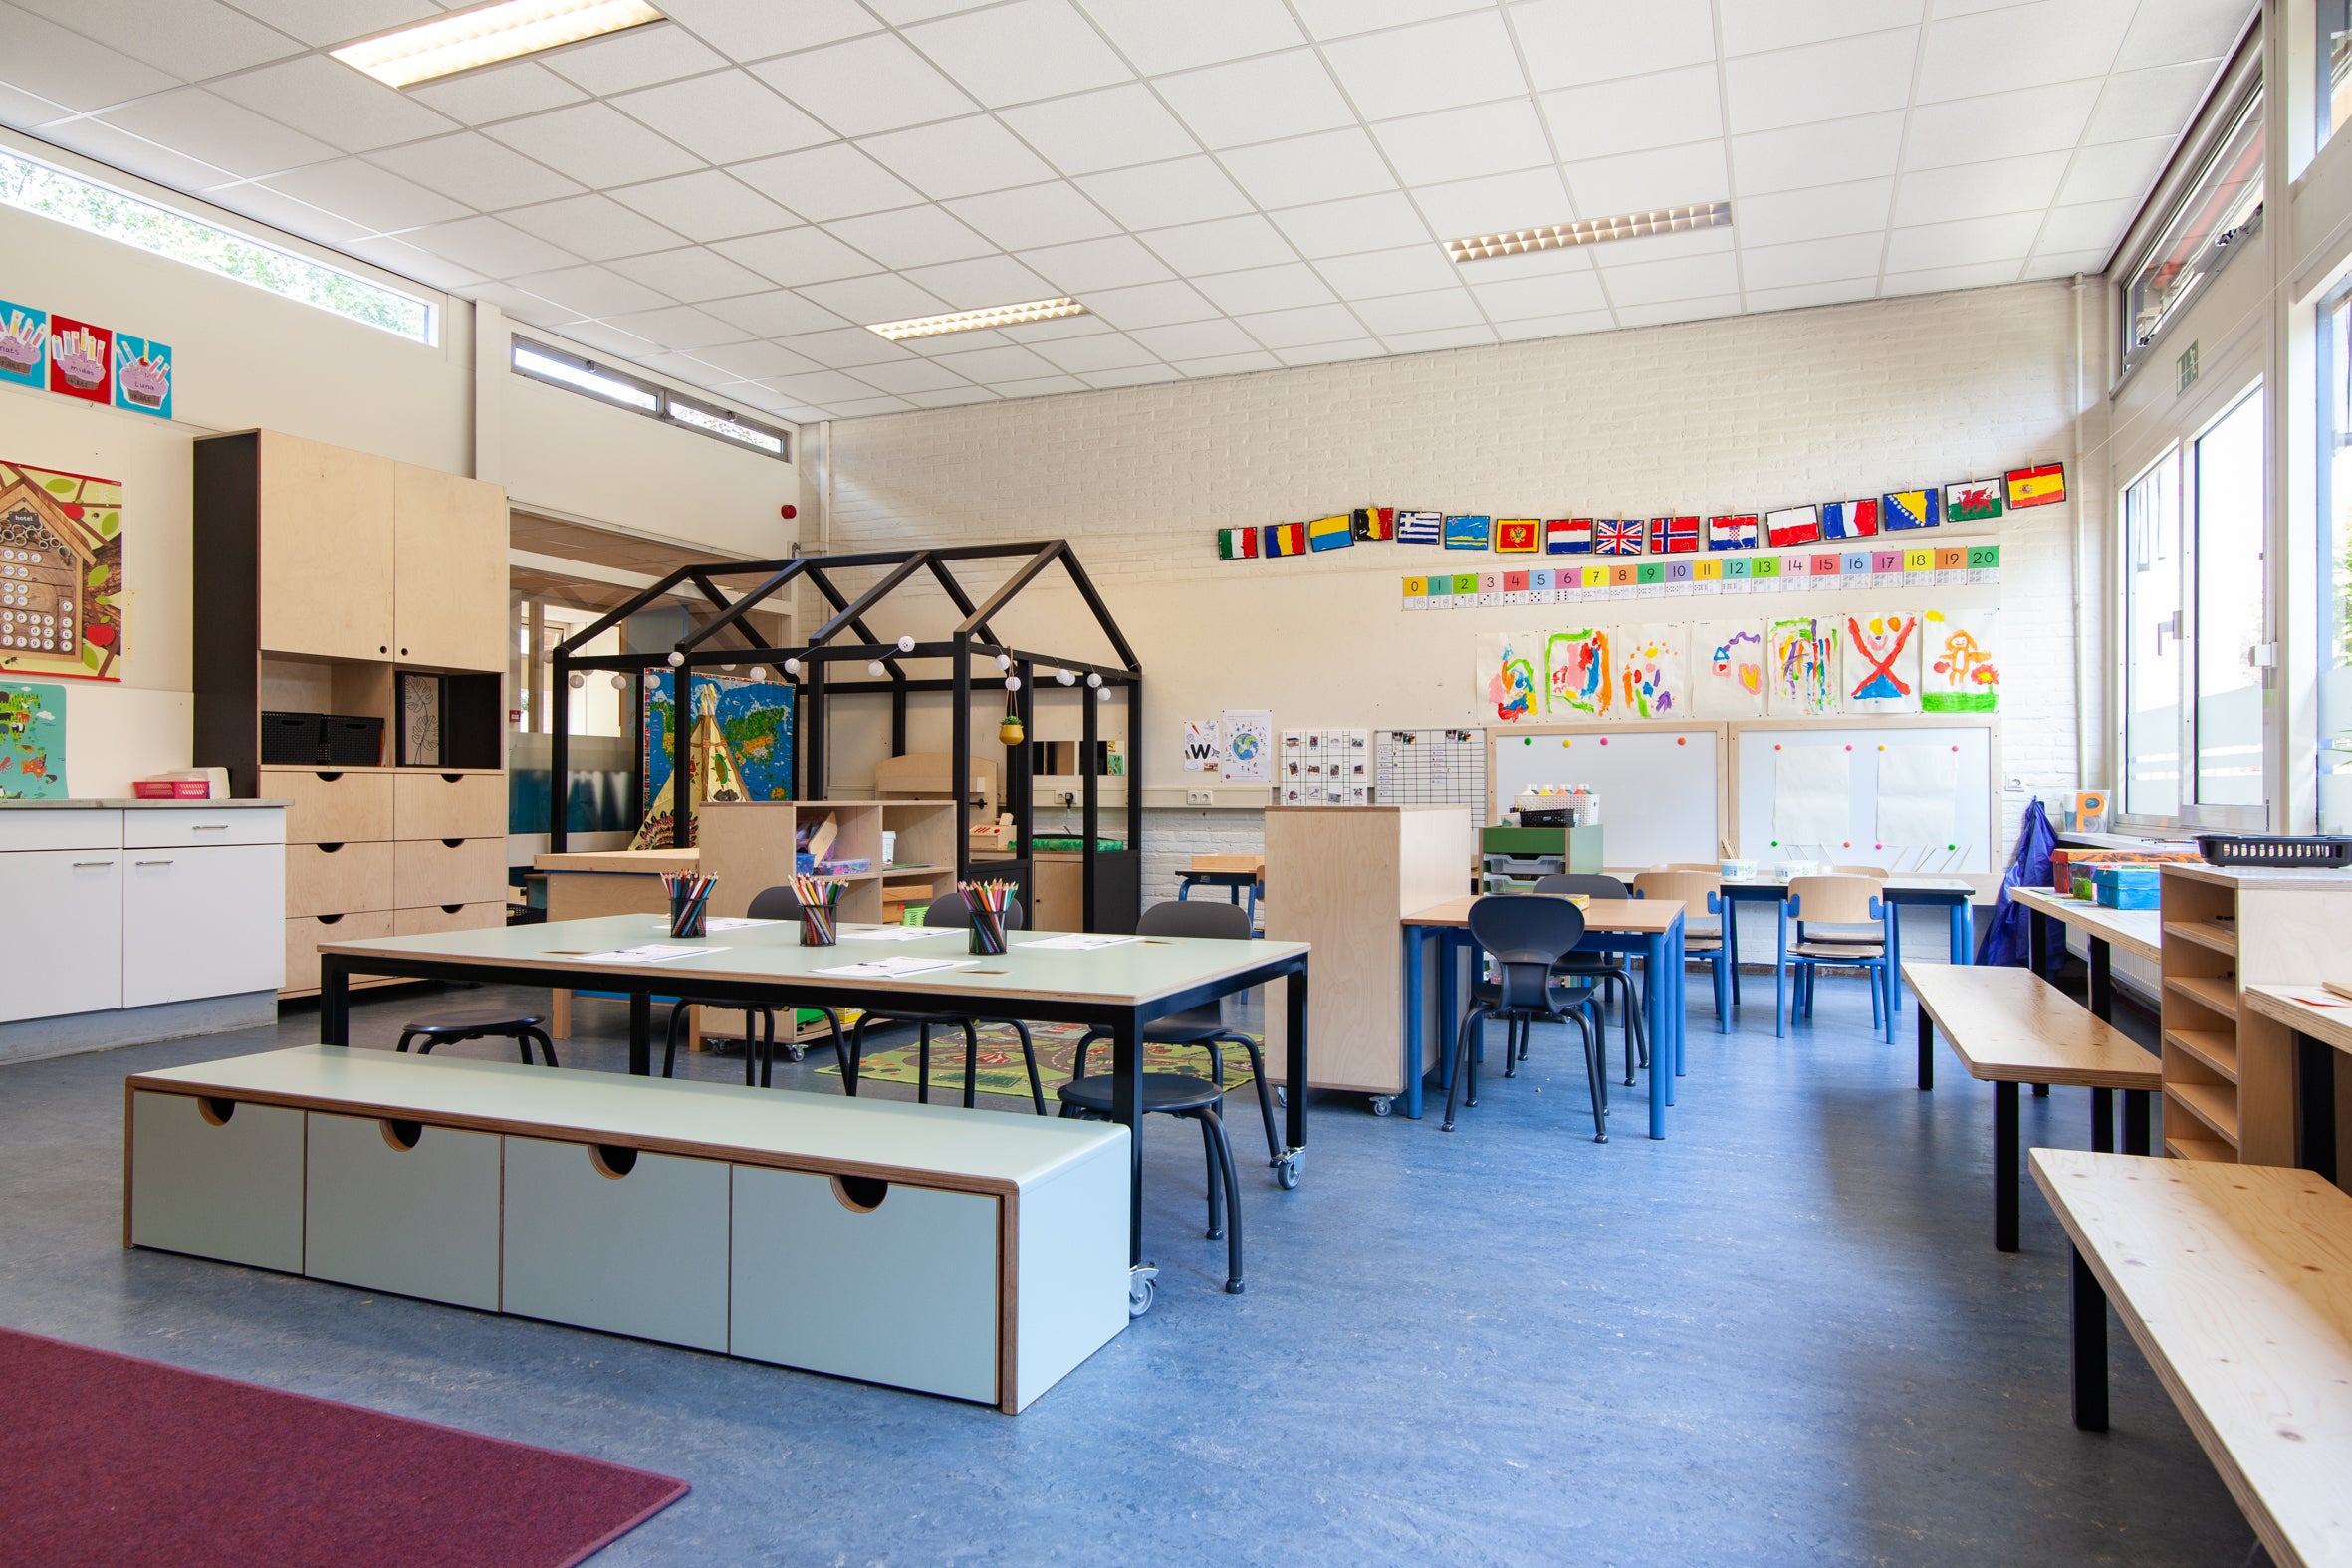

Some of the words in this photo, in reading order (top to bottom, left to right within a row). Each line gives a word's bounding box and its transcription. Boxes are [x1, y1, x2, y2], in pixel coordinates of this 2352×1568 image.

[135, 381, 154, 390] Luna
[1411, 581, 1418, 592] 0
[1460, 578, 1468, 590] 2
[1486, 577, 1494, 588] 3
[1511, 575, 1520, 587] 4
[1537, 574, 1546, 586] 5
[1564, 573, 1572, 584] 6
[1593, 571, 1599, 583] 7
[1619, 570, 1627, 581] 8
[1647, 568, 1655, 580] 9
[1673, 565, 1686, 577] 10
[1704, 564, 1710, 575] 11
[1730, 562, 1743, 574] 12
[1759, 561, 1772, 573] 13
[1789, 560, 1803, 571] 14
[1819, 558, 1833, 571] 15
[1850, 557, 1863, 570] 16
[1882, 556, 1895, 569] 17
[1911, 554, 1926, 566] 18
[1945, 553, 1959, 565] 19
[1972, 551, 1994, 564] 20
[2076, 792, 2105, 833] p
